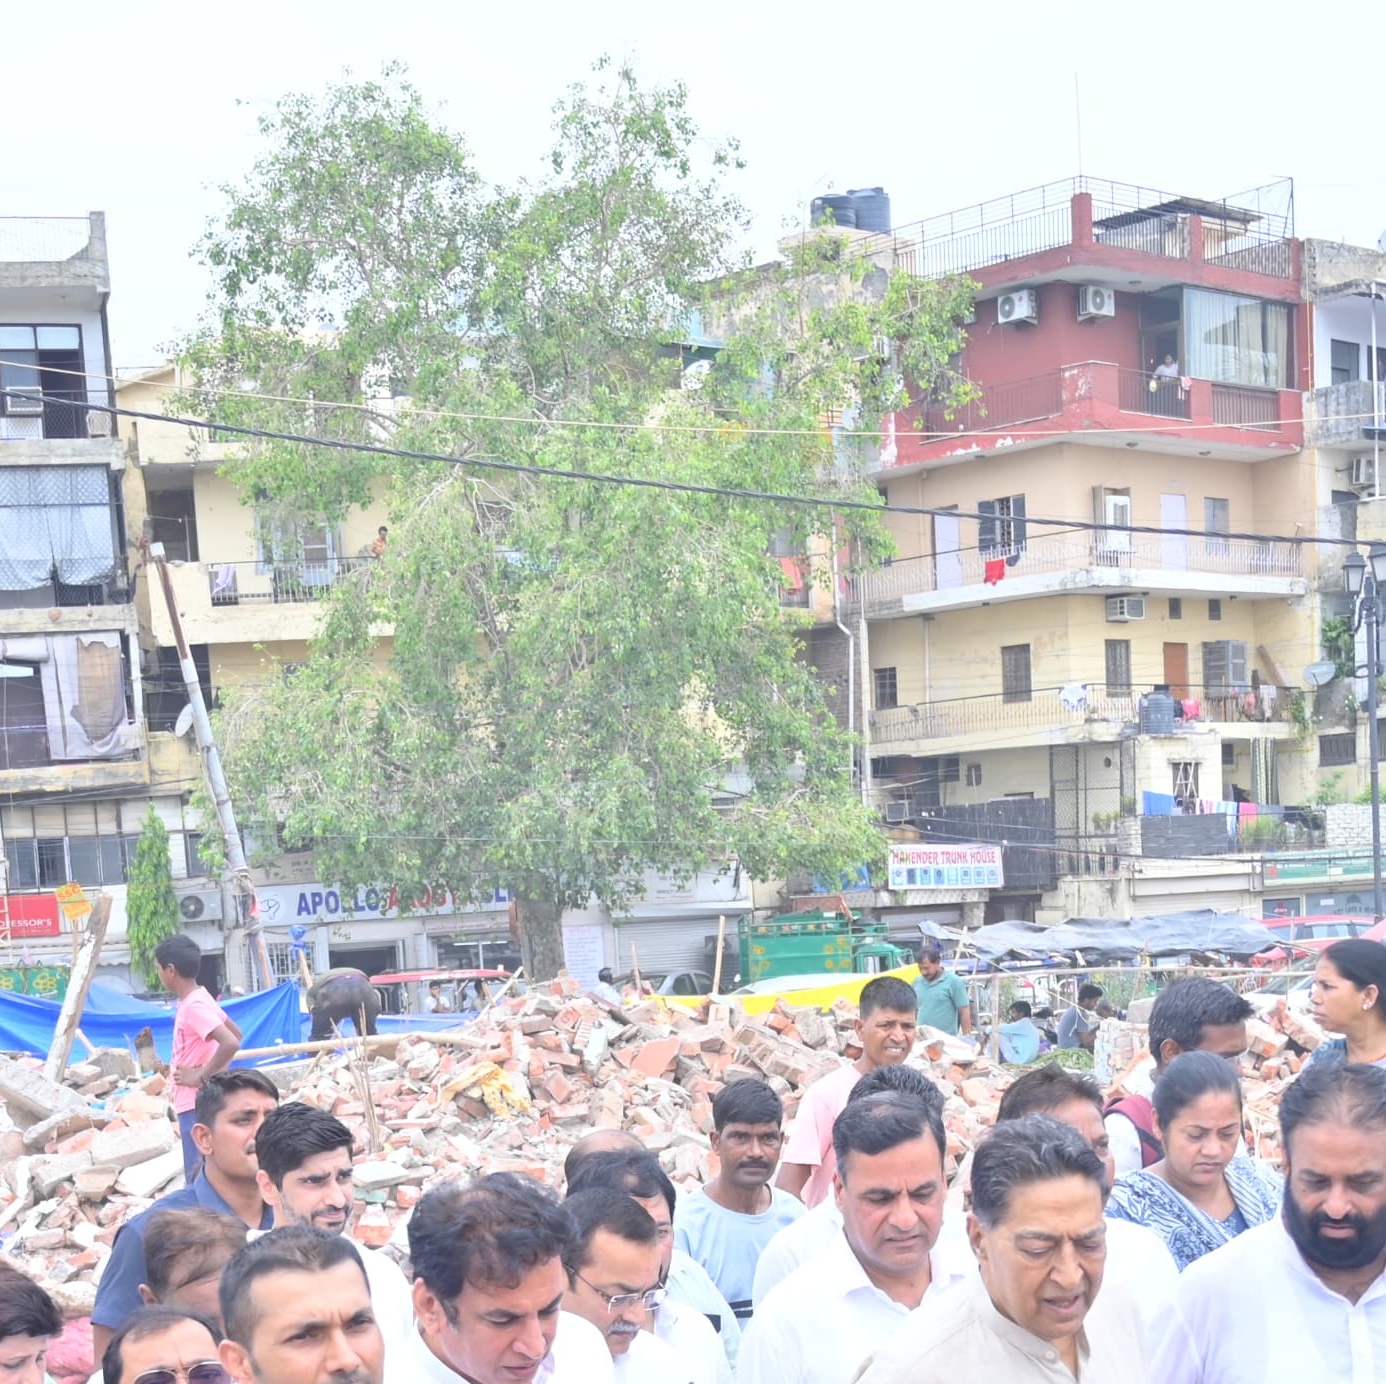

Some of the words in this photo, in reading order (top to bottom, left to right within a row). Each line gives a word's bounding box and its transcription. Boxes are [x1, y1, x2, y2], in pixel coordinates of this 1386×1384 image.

[941, 850, 968, 864] TRUNK
[970, 850, 996, 864] HOUSE
[296, 887, 380, 917] APOLO
